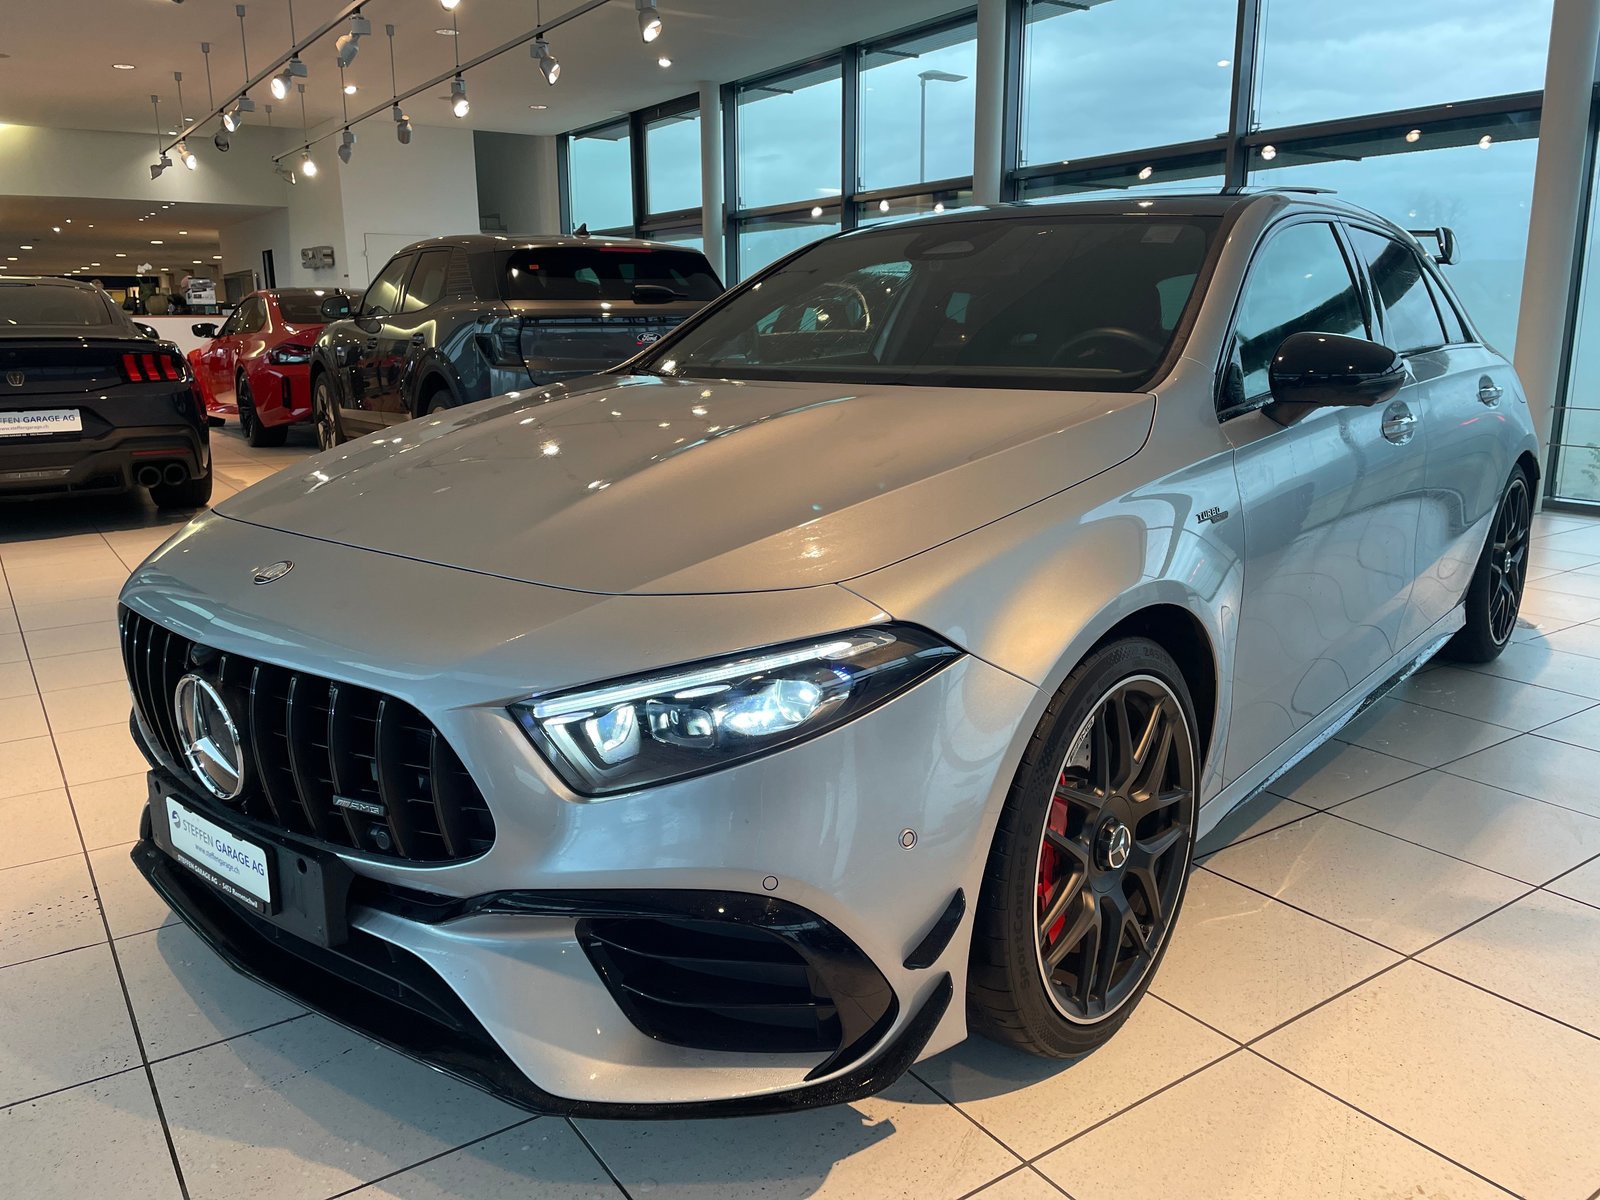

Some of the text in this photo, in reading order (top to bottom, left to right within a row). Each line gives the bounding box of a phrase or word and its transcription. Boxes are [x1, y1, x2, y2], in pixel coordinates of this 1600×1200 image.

[642, 333, 659, 342] Ford
[23, 415, 60, 424] GARAGE
[62, 414, 75, 422] AG
[1195, 506, 1220, 521] TURBO
[349, 801, 380, 815] AMG
[182, 819, 265, 876] STEFFEN GARAGE AG
[177, 854, 195, 870] STEFFEN
[194, 865, 211, 880] GARAGE
[211, 876, 218, 885] AG
[1012, 822, 1033, 990] SportContact 6
